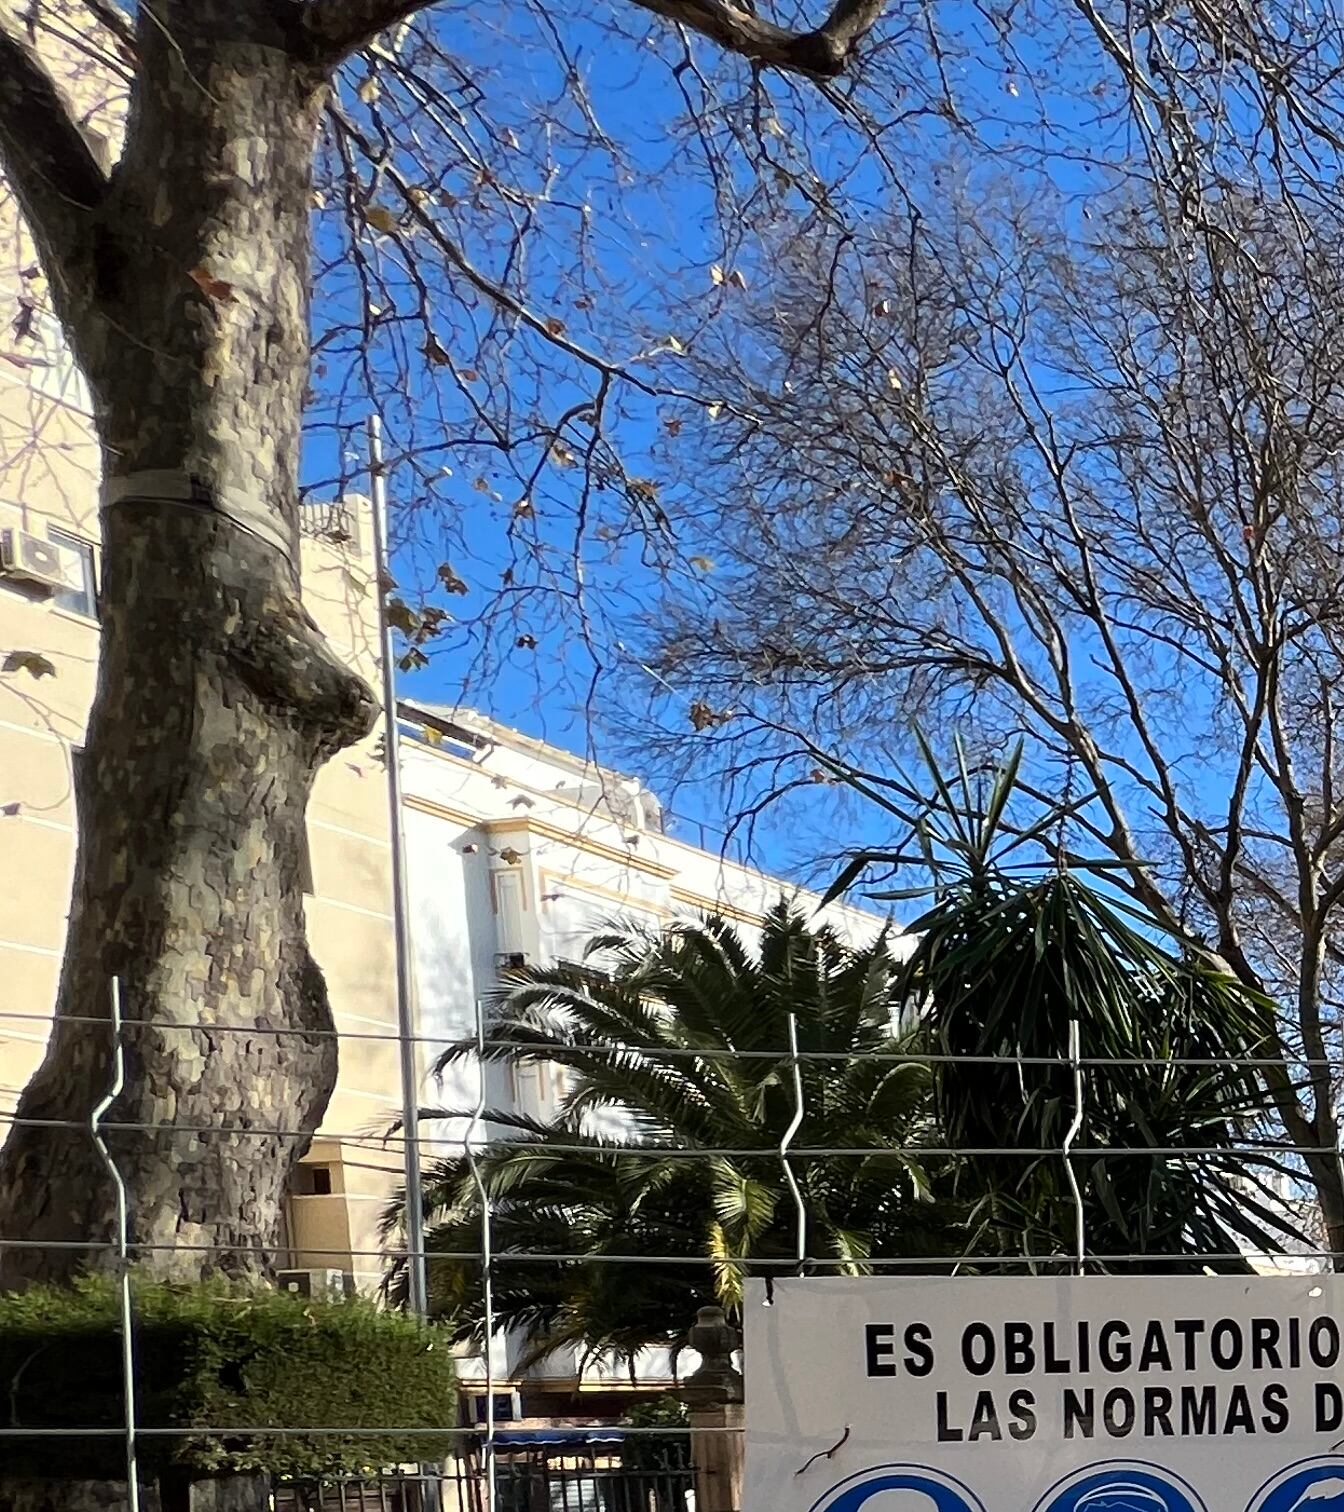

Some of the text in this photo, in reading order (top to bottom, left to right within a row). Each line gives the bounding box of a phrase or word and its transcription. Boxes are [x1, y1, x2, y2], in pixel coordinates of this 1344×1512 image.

[865, 1322, 934, 1377] ES
[961, 1316, 1340, 1376] OBLIGATORIO
[936, 1388, 1038, 1443] LAS
[1063, 1384, 1290, 1438] NORMAS
